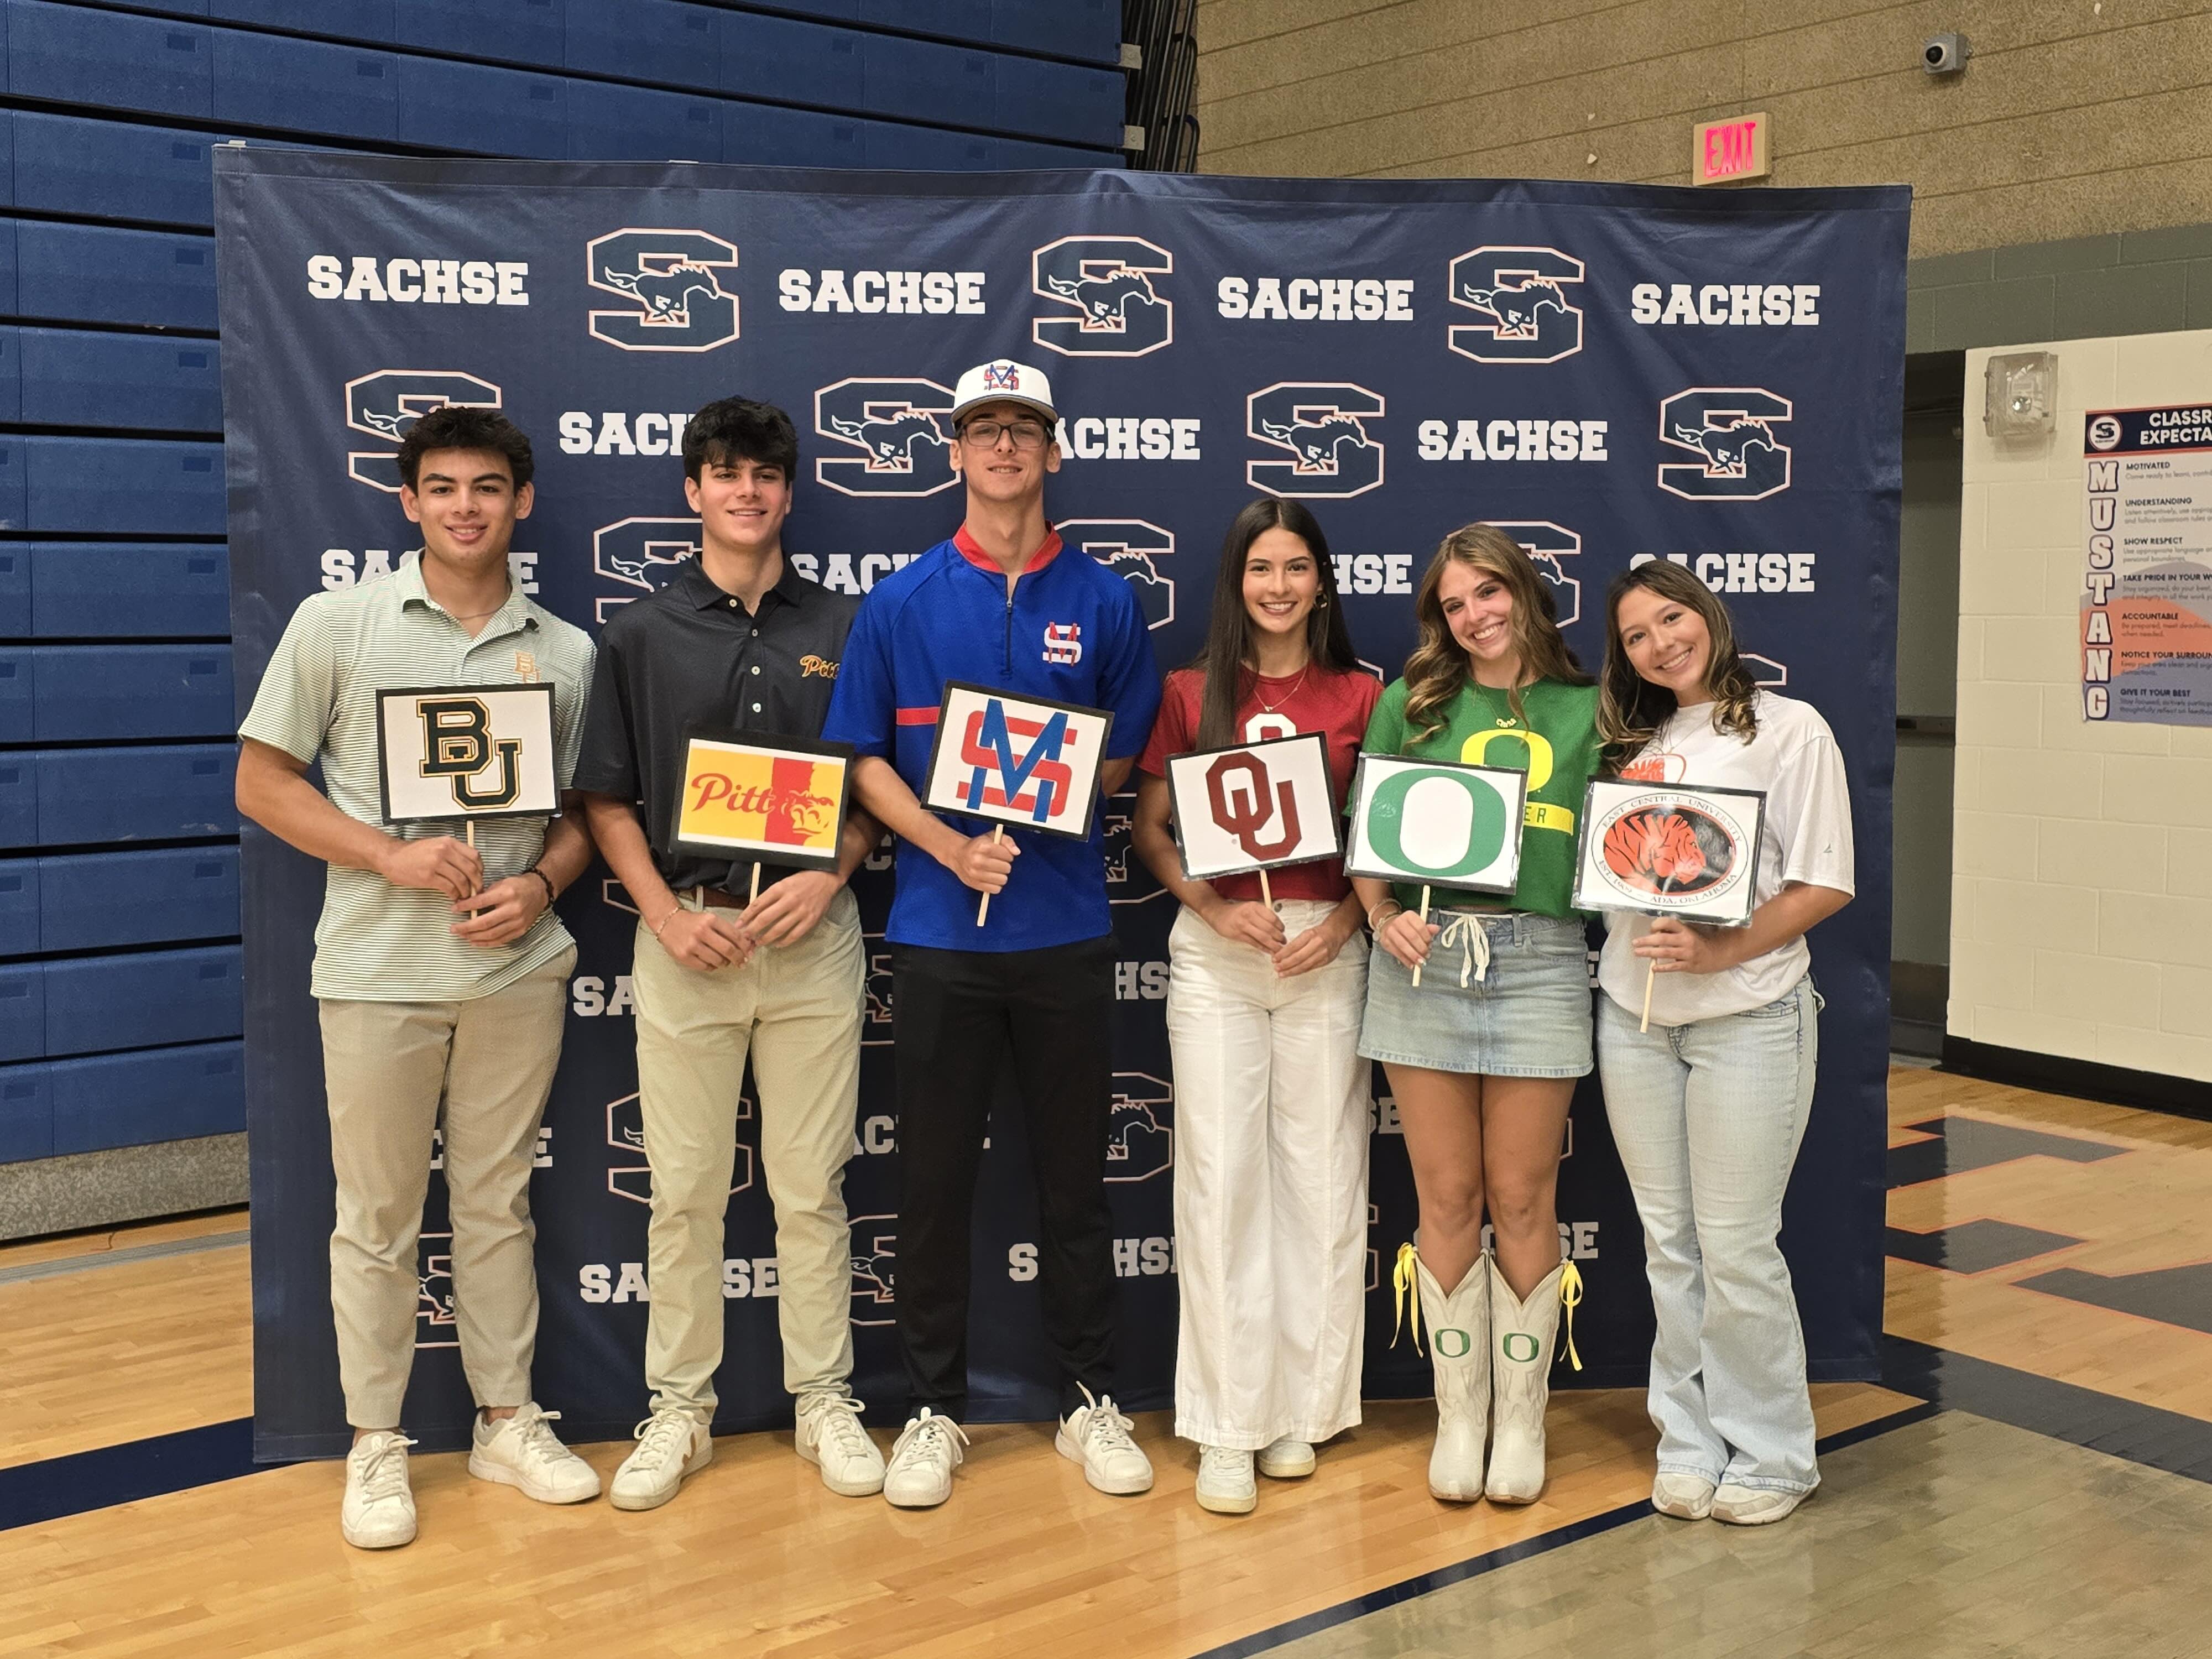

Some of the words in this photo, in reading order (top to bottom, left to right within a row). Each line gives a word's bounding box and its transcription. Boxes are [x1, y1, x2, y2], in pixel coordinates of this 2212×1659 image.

[1705, 121, 1757, 178] EXIT
[307, 255, 529, 305] SACHSE
[779, 269, 985, 314] SACHSE
[1218, 277, 1414, 321] SACHSE
[1631, 284, 1820, 325] SACHSE
[559, 411, 696, 456] SACH
[2140, 427, 2212, 445] EXPECTA
[2149, 409, 2212, 427] CLASSR
[1055, 418, 1200, 460] CHSE
[1418, 420, 1608, 461] SACHSE
[2126, 462, 2171, 470] MOTIVATED
[2125, 498, 2192, 507] UNDERSTANDING
[321, 549, 539, 593] SAE
[790, 554, 922, 594] SAC
[1630, 554, 1814, 592] CHSE
[416, 697, 522, 811] BU
[691, 773, 776, 814] Pitt
[1206, 750, 1302, 862] OU
[1367, 768, 1507, 878] O
[1602, 806, 1624, 828] EAST
[1631, 796, 1683, 807] CENTRAL
[1688, 799, 1743, 842] UNIVERSITY
[1679, 874, 1737, 904] OKLAHOMA
[580, 1258, 779, 1303] SASE
[1434, 1328, 1471, 1358] O
[1503, 1333, 1540, 1363] O
